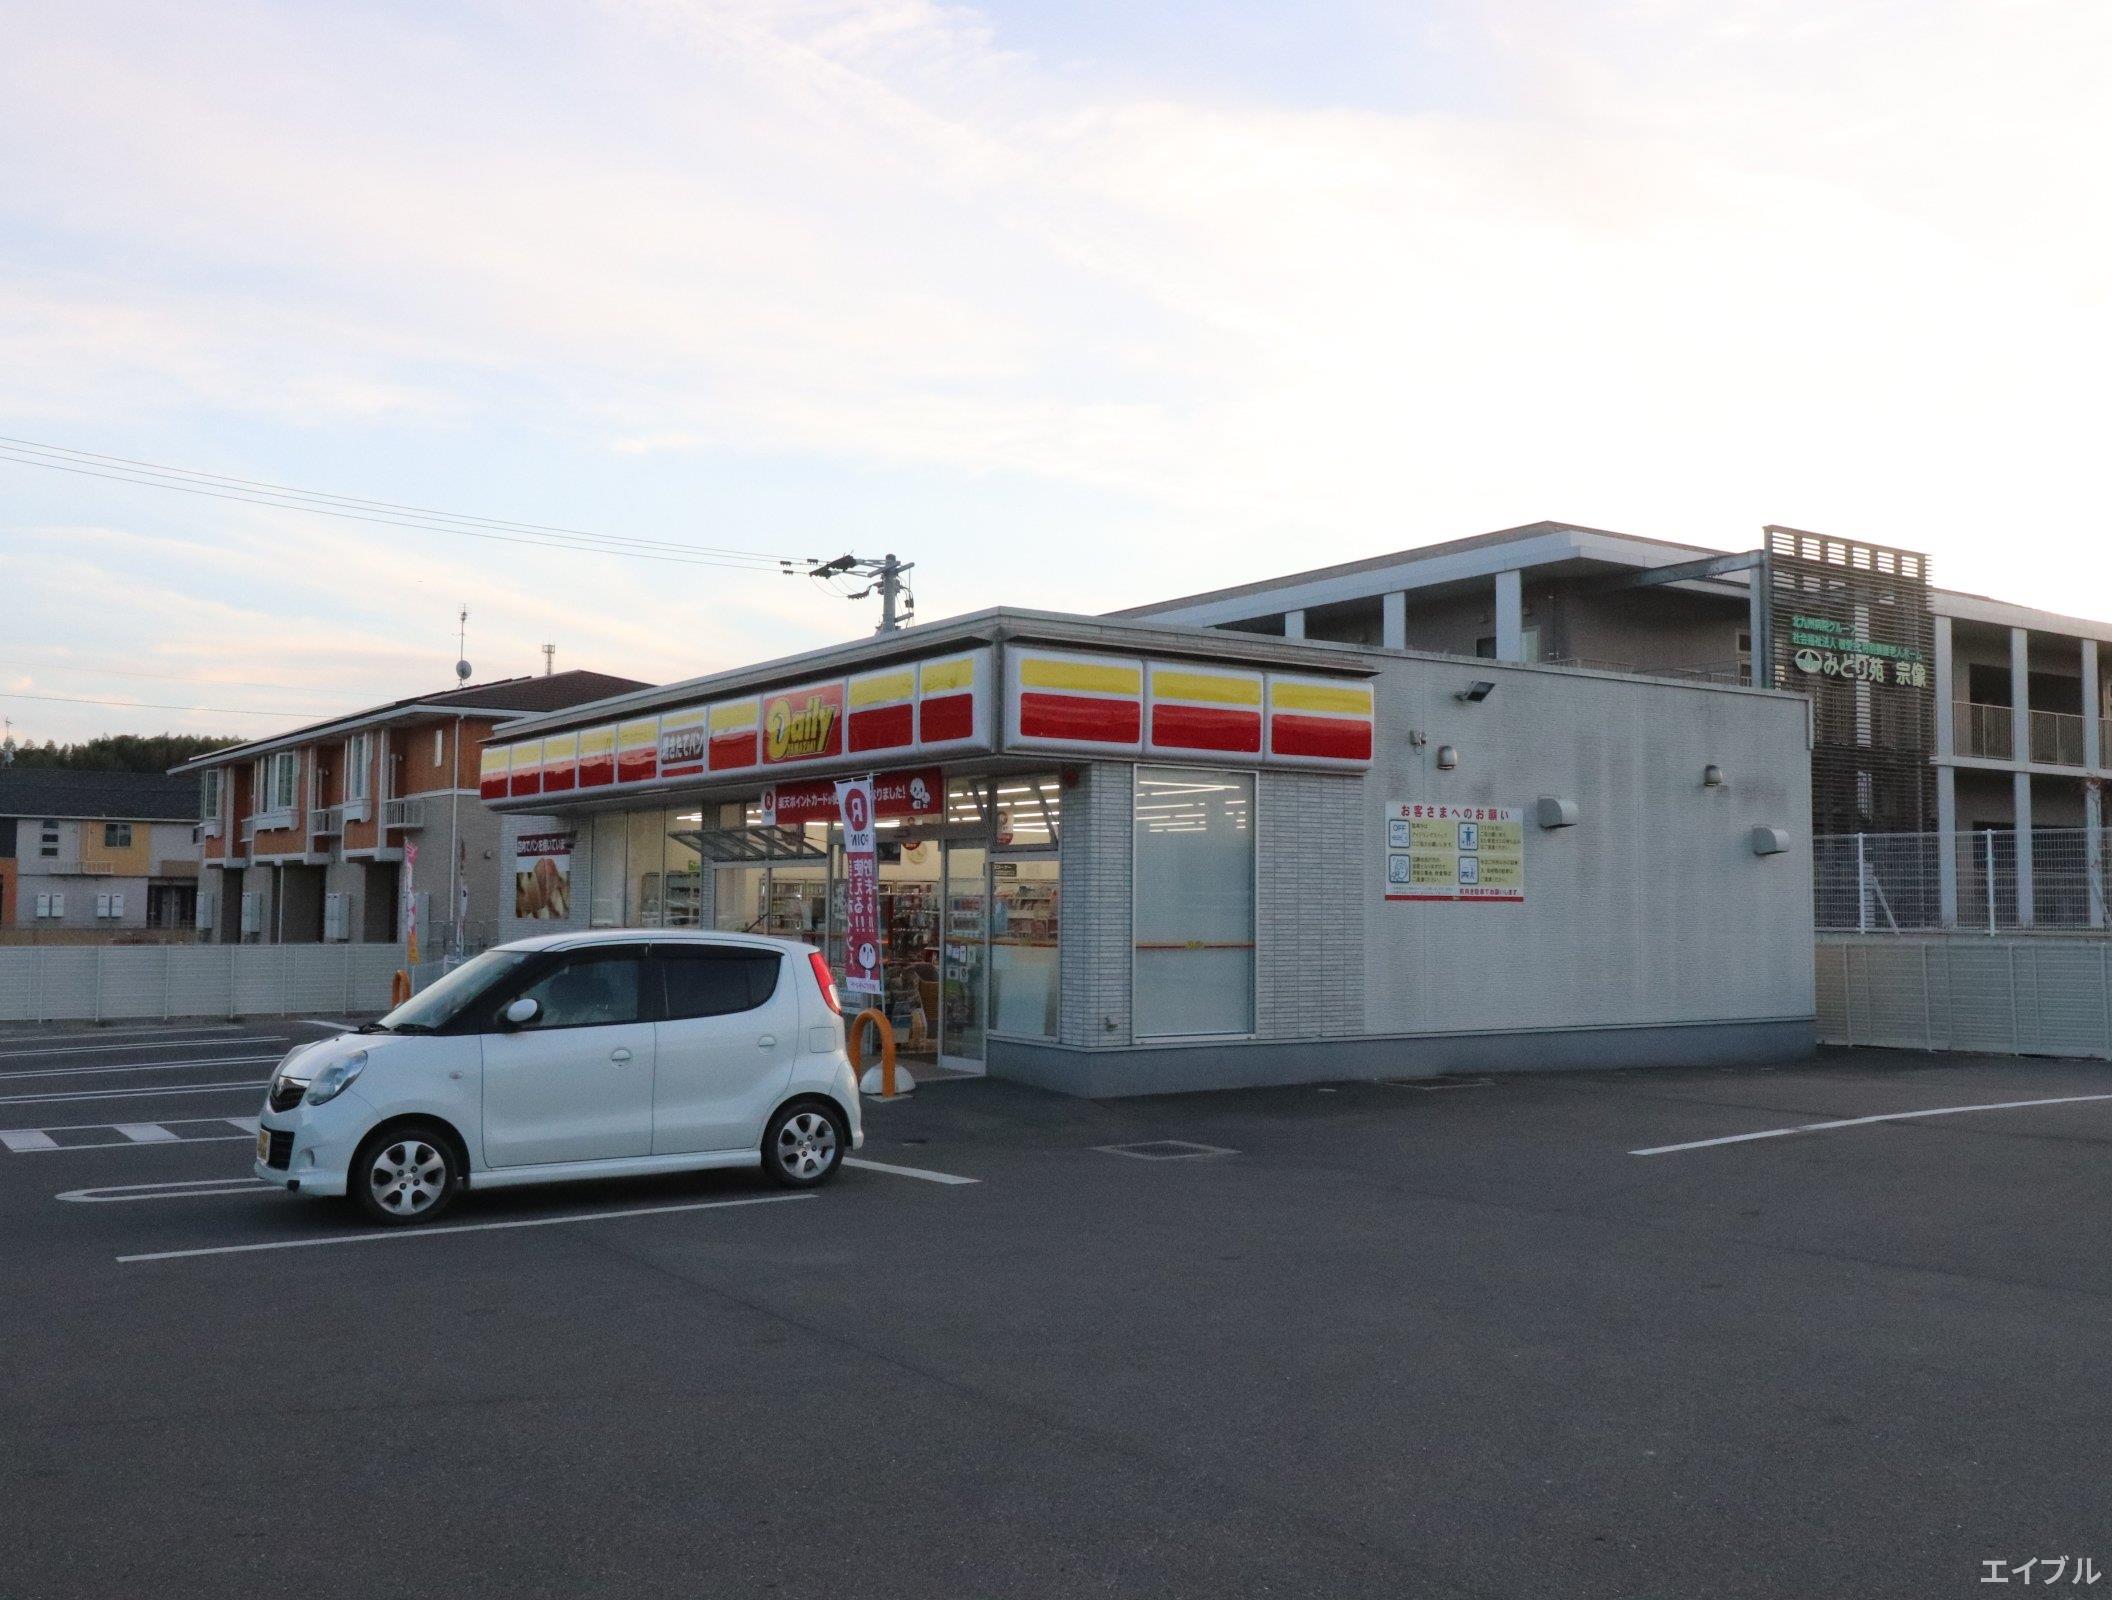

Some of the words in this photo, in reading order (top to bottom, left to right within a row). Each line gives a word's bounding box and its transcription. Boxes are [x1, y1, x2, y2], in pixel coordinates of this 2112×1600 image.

[767, 696, 838, 760] Daily
[1401, 805, 1509, 821] お客さまへのお願い
[1393, 824, 1406, 832] OFF
